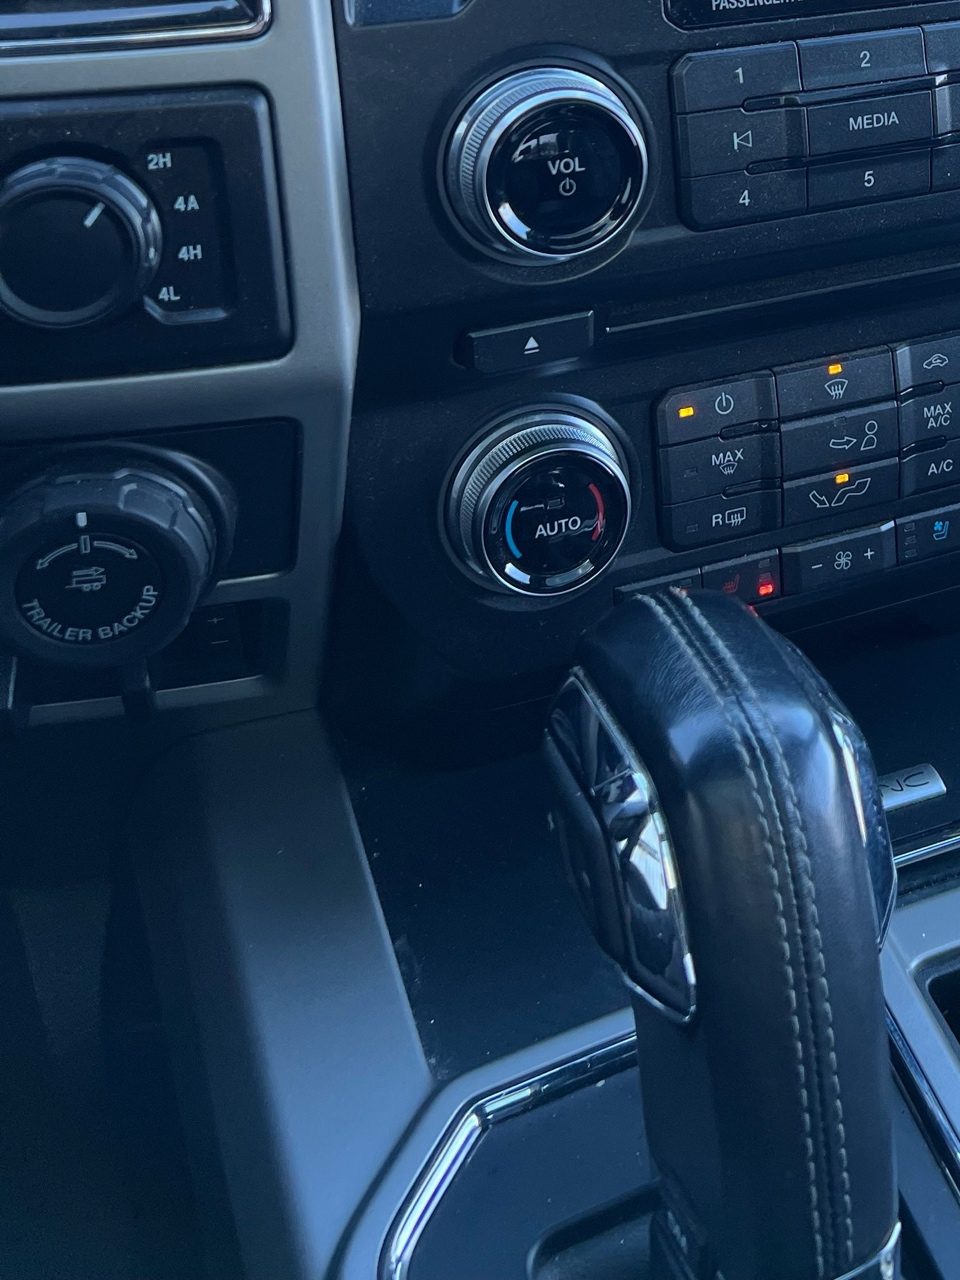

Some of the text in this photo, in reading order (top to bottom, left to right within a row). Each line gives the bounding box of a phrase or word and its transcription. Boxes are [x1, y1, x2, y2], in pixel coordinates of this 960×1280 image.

[860, 51, 871, 67] 2
[734, 67, 744, 84] 1
[849, 111, 899, 131] MEDIA
[147, 152, 172, 170] 2H
[547, 157, 586, 176] VOL
[863, 171, 875, 187] 5
[173, 194, 200, 211] 4A
[738, 189, 750, 207] 4
[178, 245, 202, 261] 4H
[158, 286, 181, 301] 4L
[923, 401, 952, 419] MAX
[927, 414, 951, 430] A/C
[711, 448, 744, 466] MAX
[927, 458, 954, 476] A/C
[535, 516, 581, 539] AUTO
[712, 513, 722, 527] R
[22, 584, 159, 641] TRAILER BACKUP
